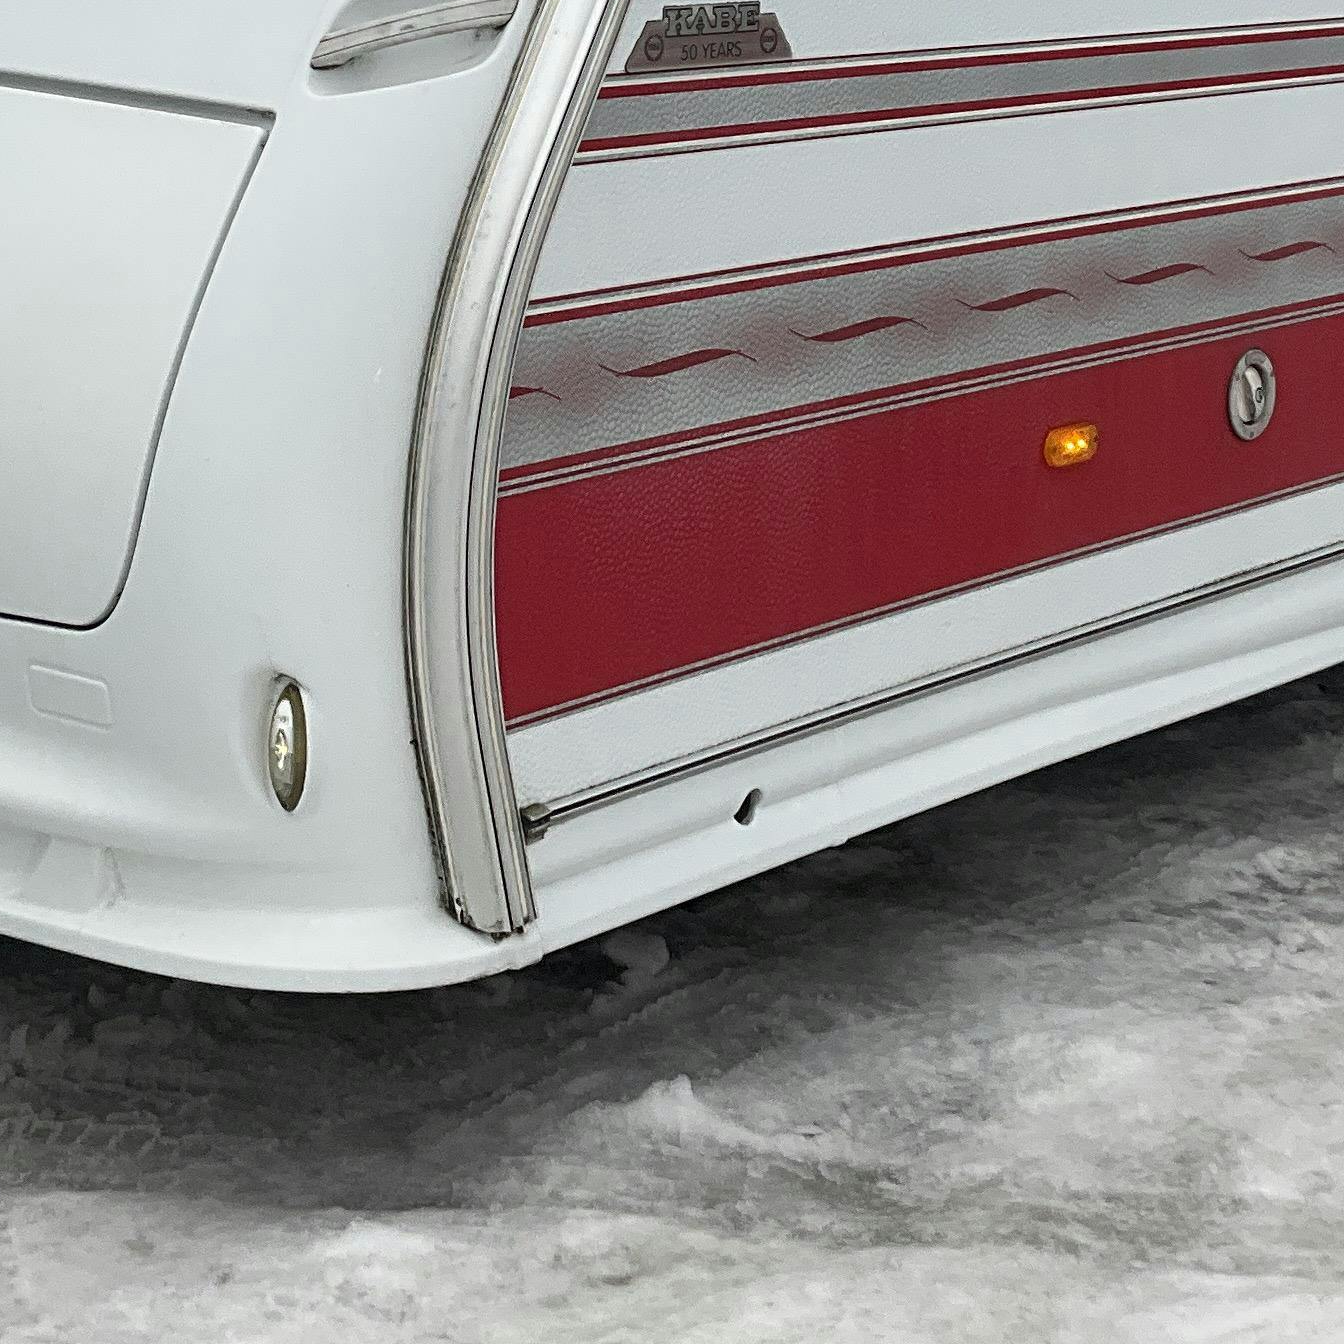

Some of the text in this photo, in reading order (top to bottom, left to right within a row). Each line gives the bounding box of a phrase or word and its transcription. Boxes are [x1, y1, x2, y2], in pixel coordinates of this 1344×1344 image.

[664, 3, 761, 39] KABE
[681, 40, 743, 62] 50 YEARS
